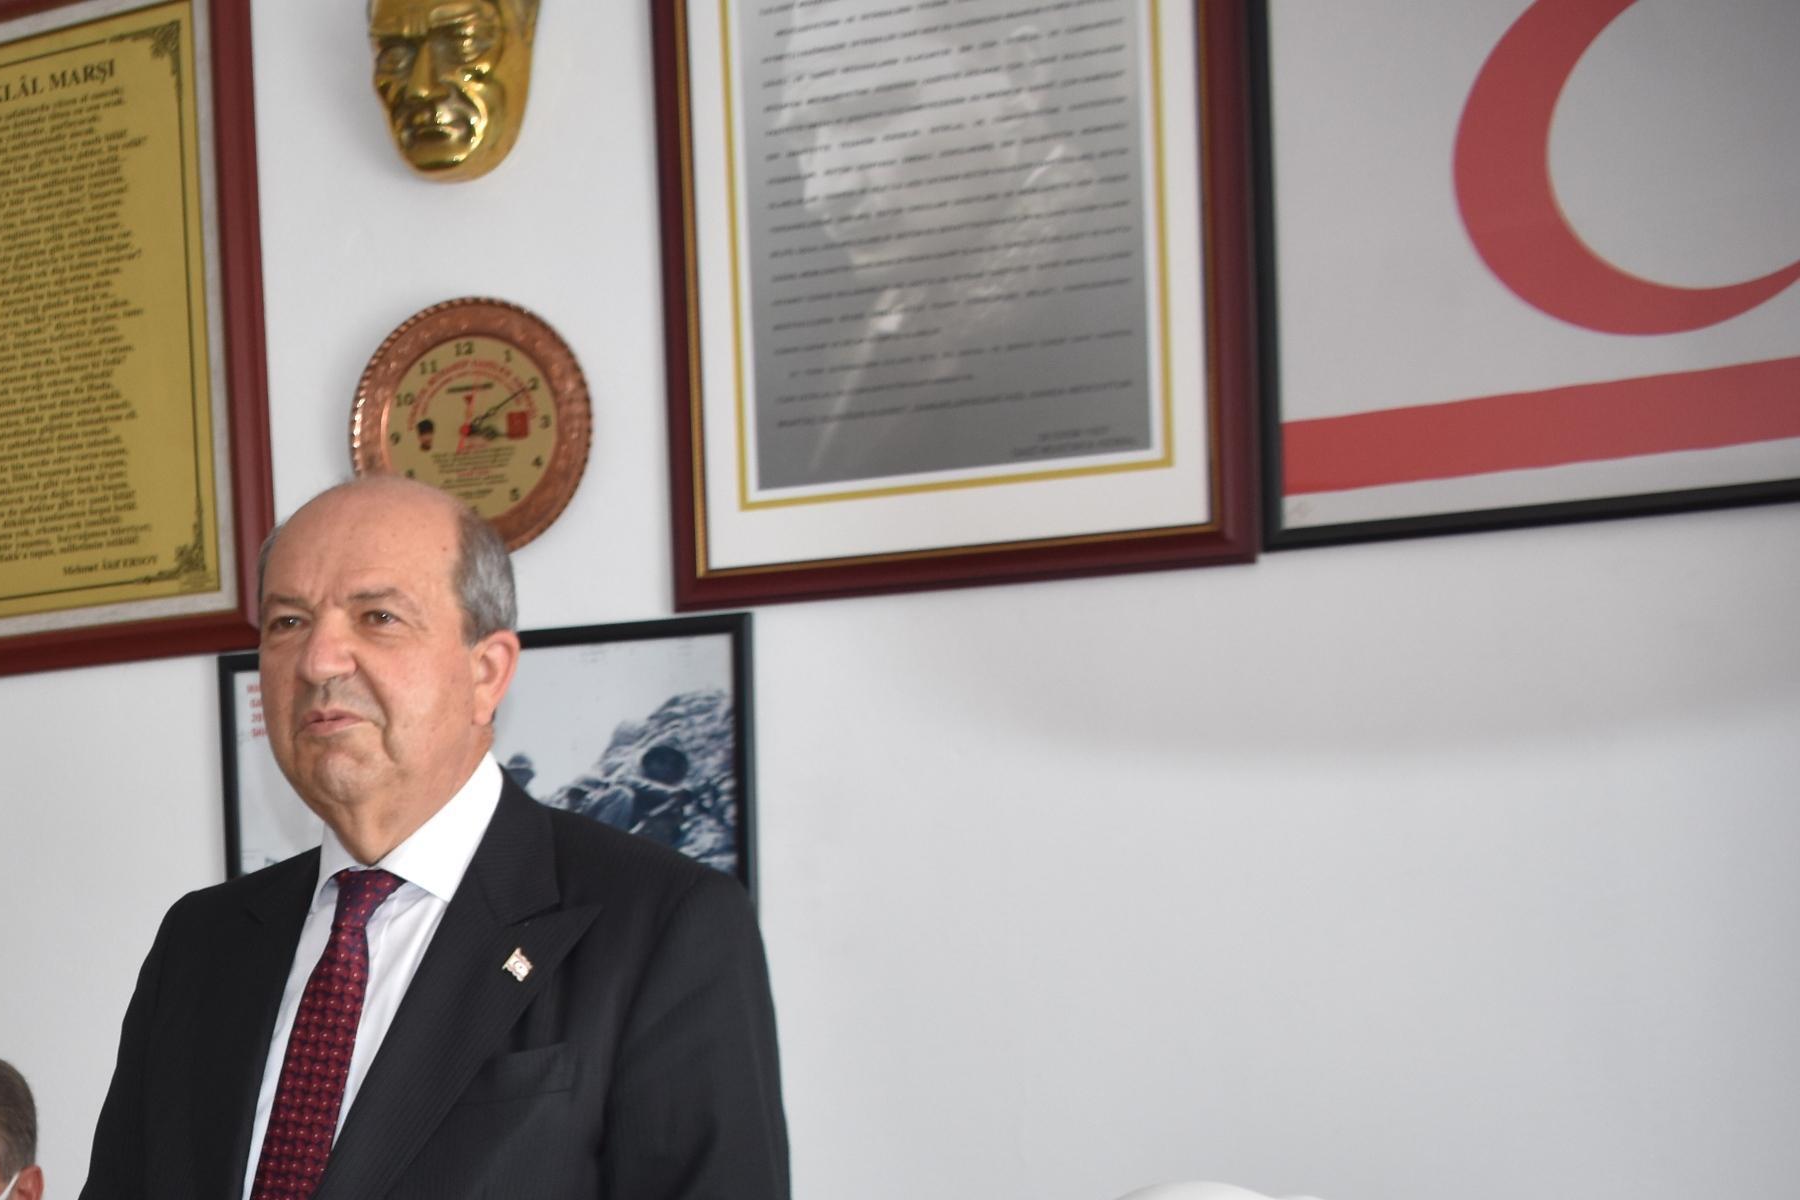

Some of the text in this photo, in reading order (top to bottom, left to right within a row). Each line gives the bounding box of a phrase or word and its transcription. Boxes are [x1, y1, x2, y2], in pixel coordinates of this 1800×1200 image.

[49, 59, 115, 91] MARŞI
[455, 342, 474, 356] 12
[505, 350, 512, 362] 1
[420, 361, 437, 373] 11
[397, 393, 413, 407] 10
